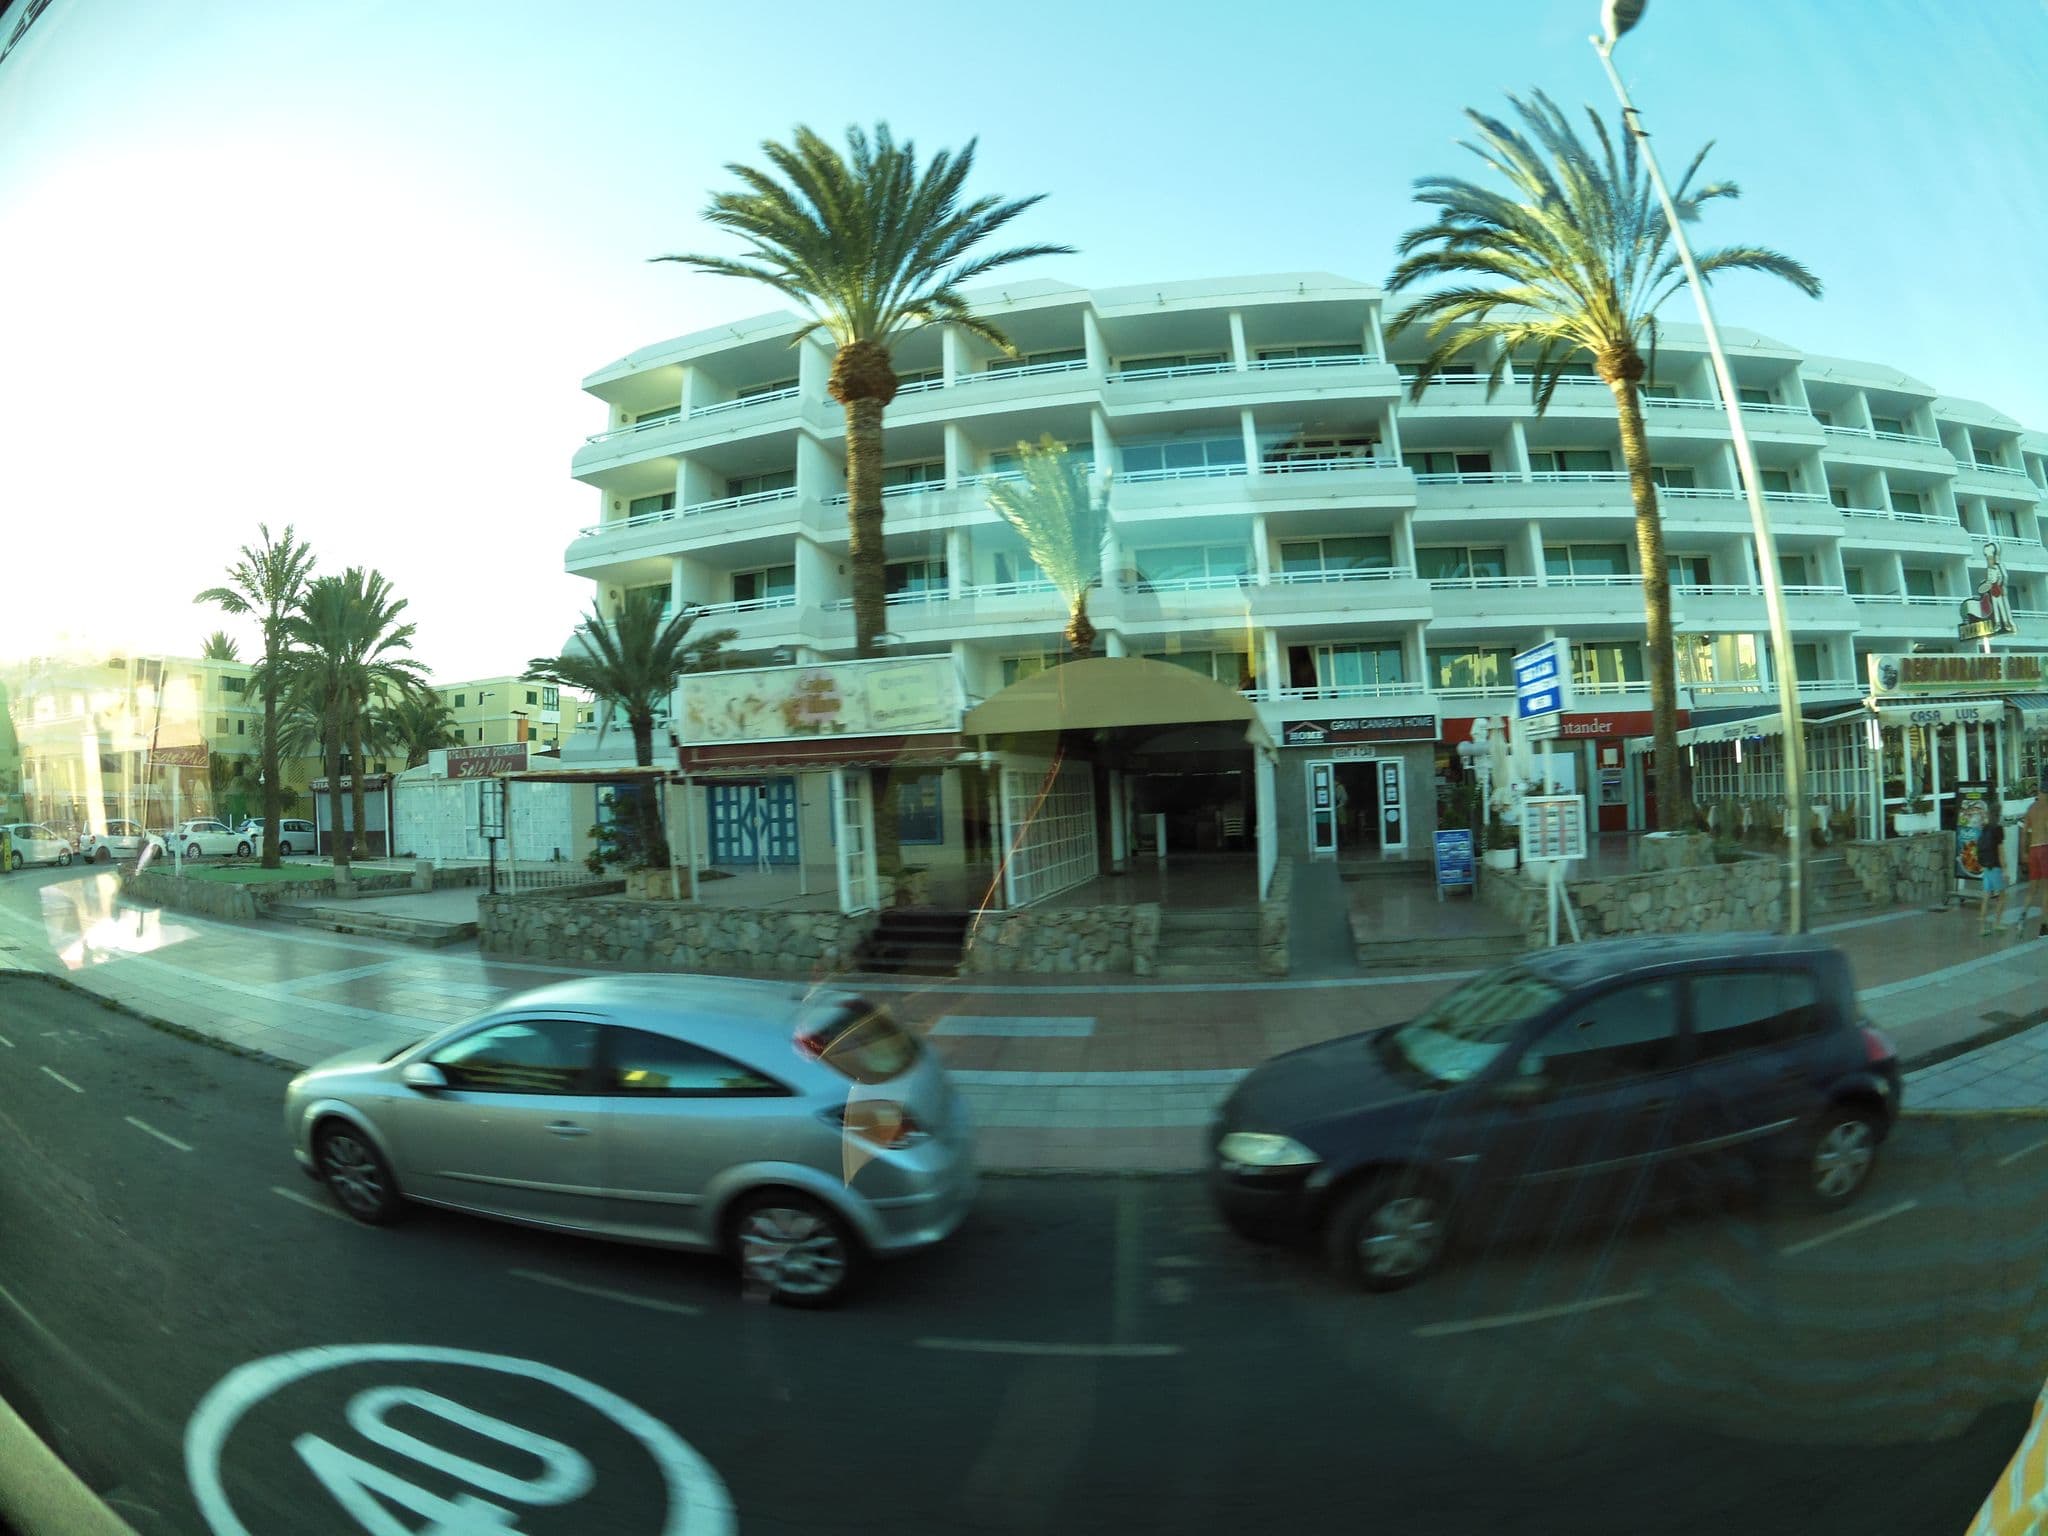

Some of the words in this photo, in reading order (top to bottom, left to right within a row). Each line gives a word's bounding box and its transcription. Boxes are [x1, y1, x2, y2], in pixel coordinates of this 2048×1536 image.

[1910, 710, 1941, 722] CASA
[1955, 708, 1979, 719] LUIS
[1329, 719, 1360, 731] GRAN
[1360, 718, 1403, 730] CANARIA
[1404, 716, 1433, 728] HOME
[1561, 718, 1614, 734] ntander
[292, 1386, 597, 1536] 40
